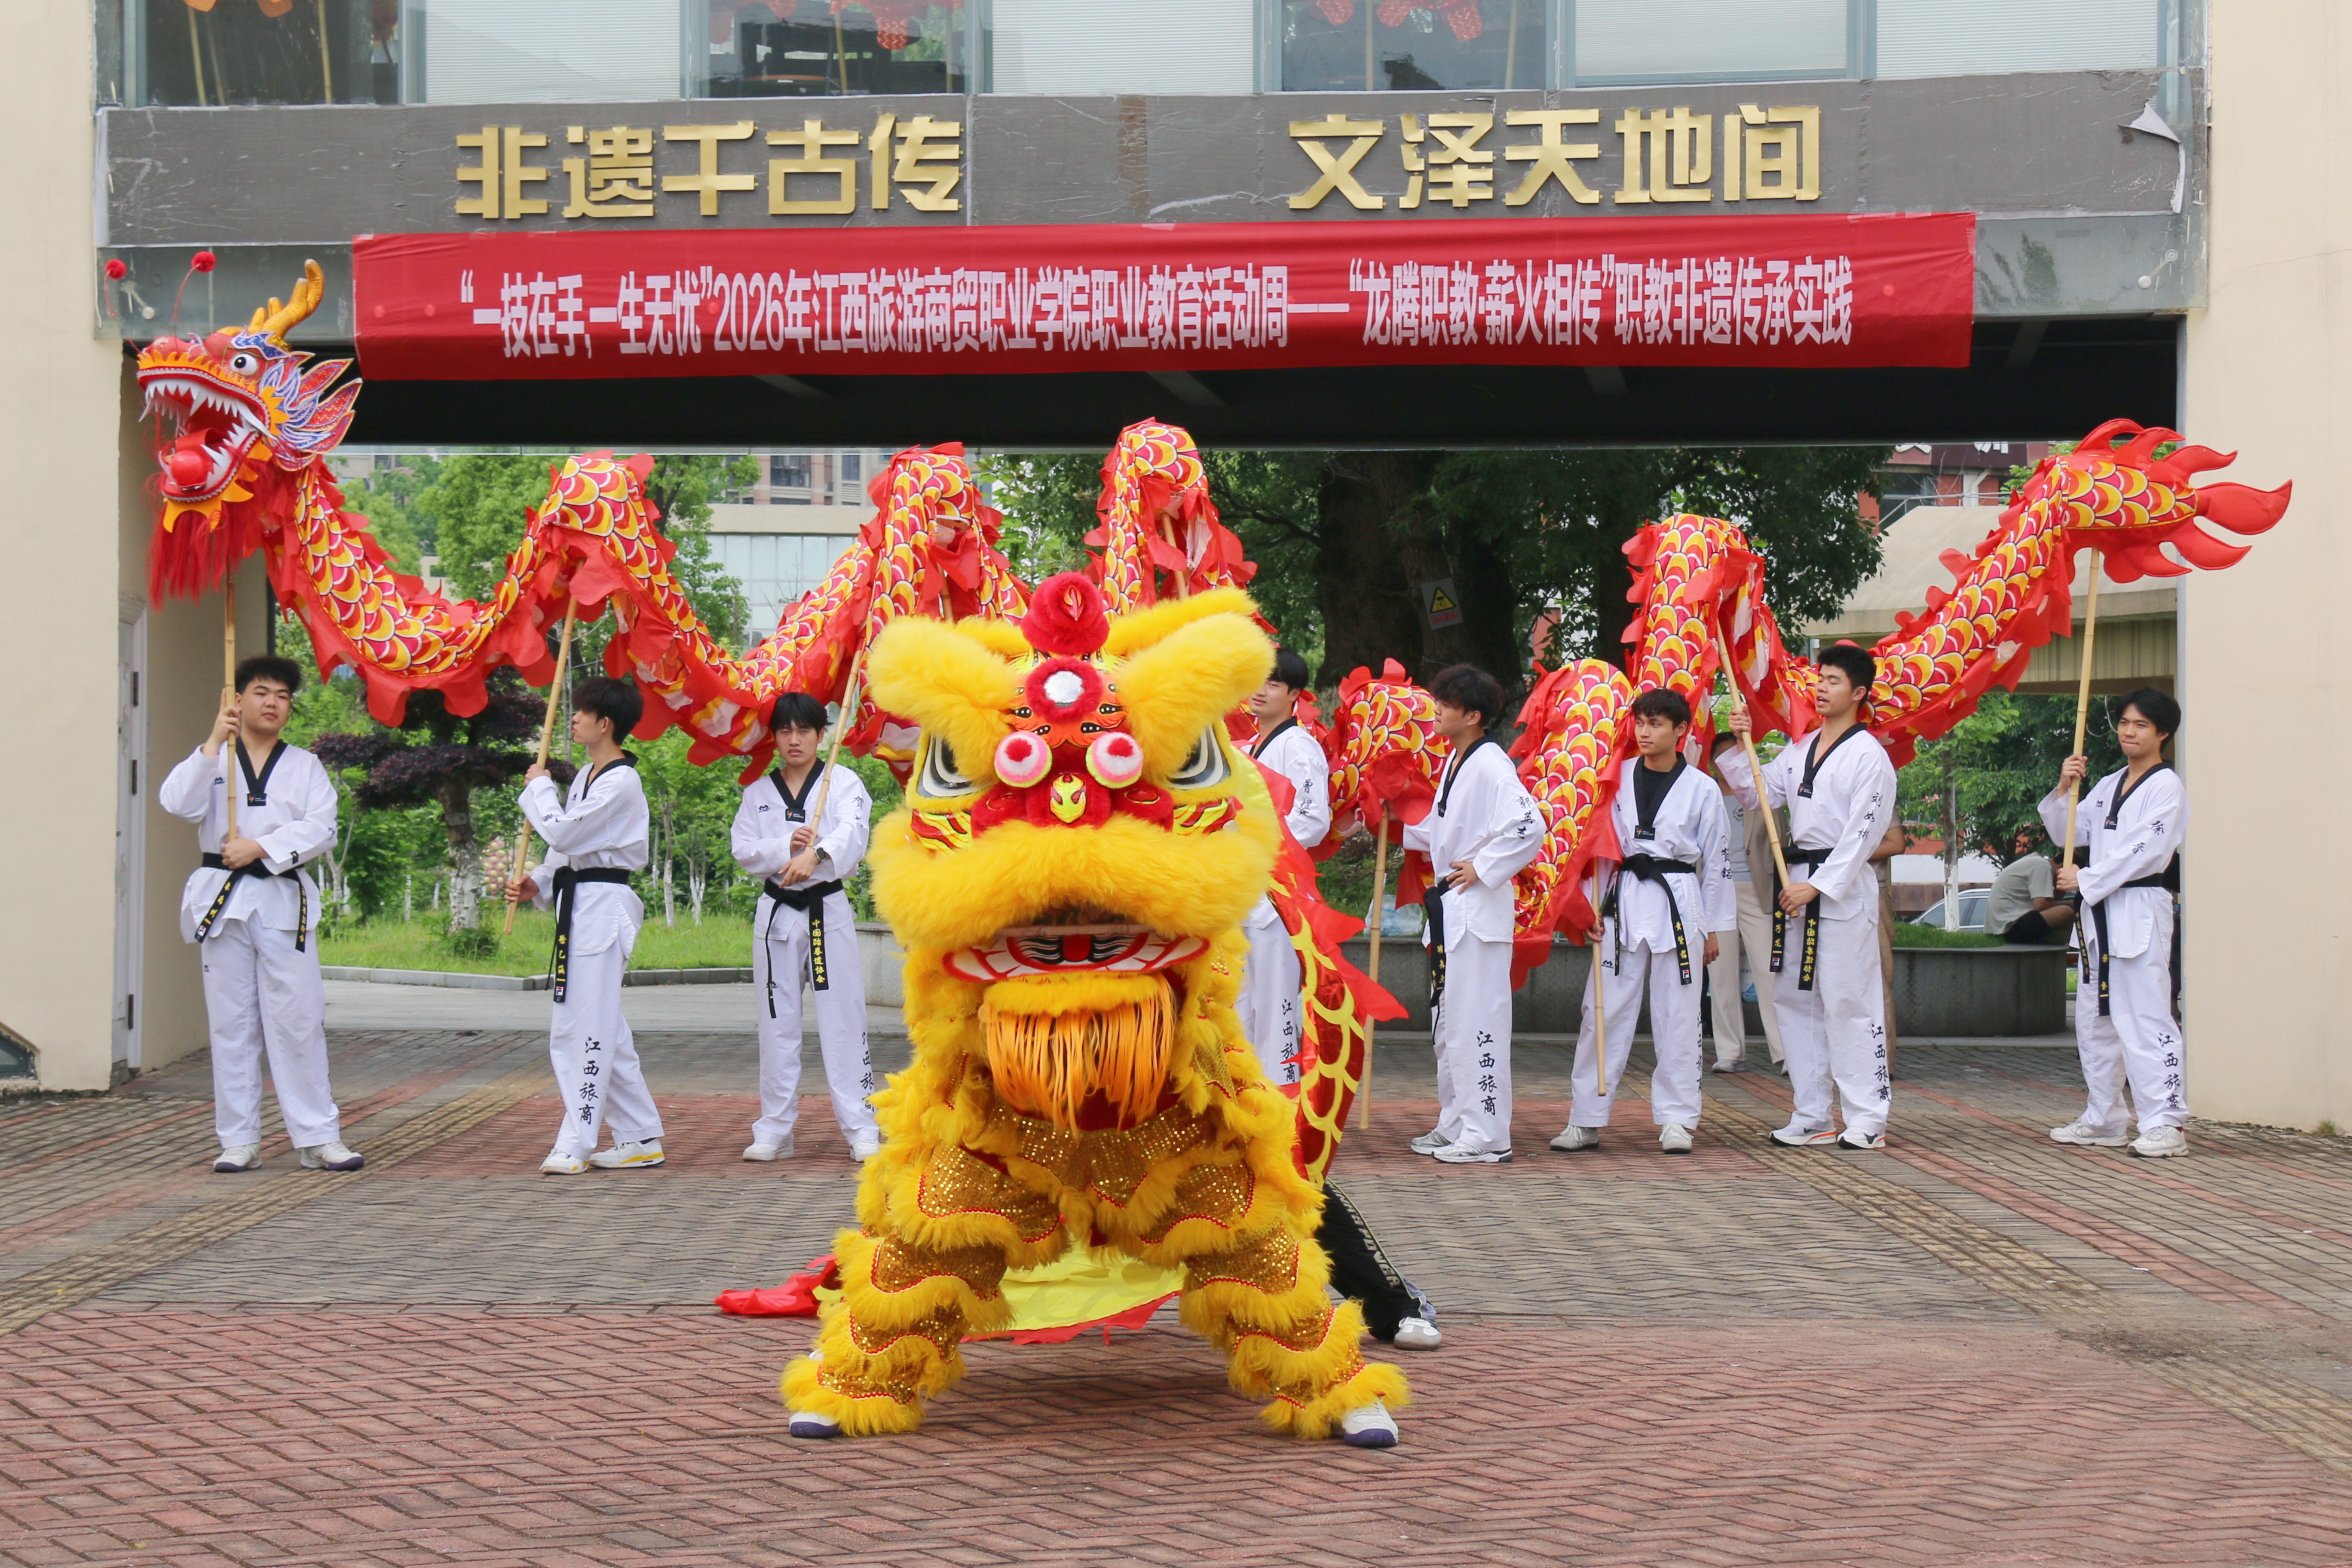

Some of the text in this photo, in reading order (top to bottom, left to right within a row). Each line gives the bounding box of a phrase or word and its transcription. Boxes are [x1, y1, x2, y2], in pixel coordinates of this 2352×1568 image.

[455, 105, 1821, 218] 非遗千古传 文泽天地间
[812, 919, 826, 983] 中国跆拳道协会
[579, 1036, 601, 1125] 江西旅商
[1281, 999, 1295, 1083] 江西旅商
[1477, 1030, 1497, 1115] 江西旅商
[1871, 1023, 1893, 1103] 江西旅商
[2158, 1032, 2180, 1109] 江西旅商
